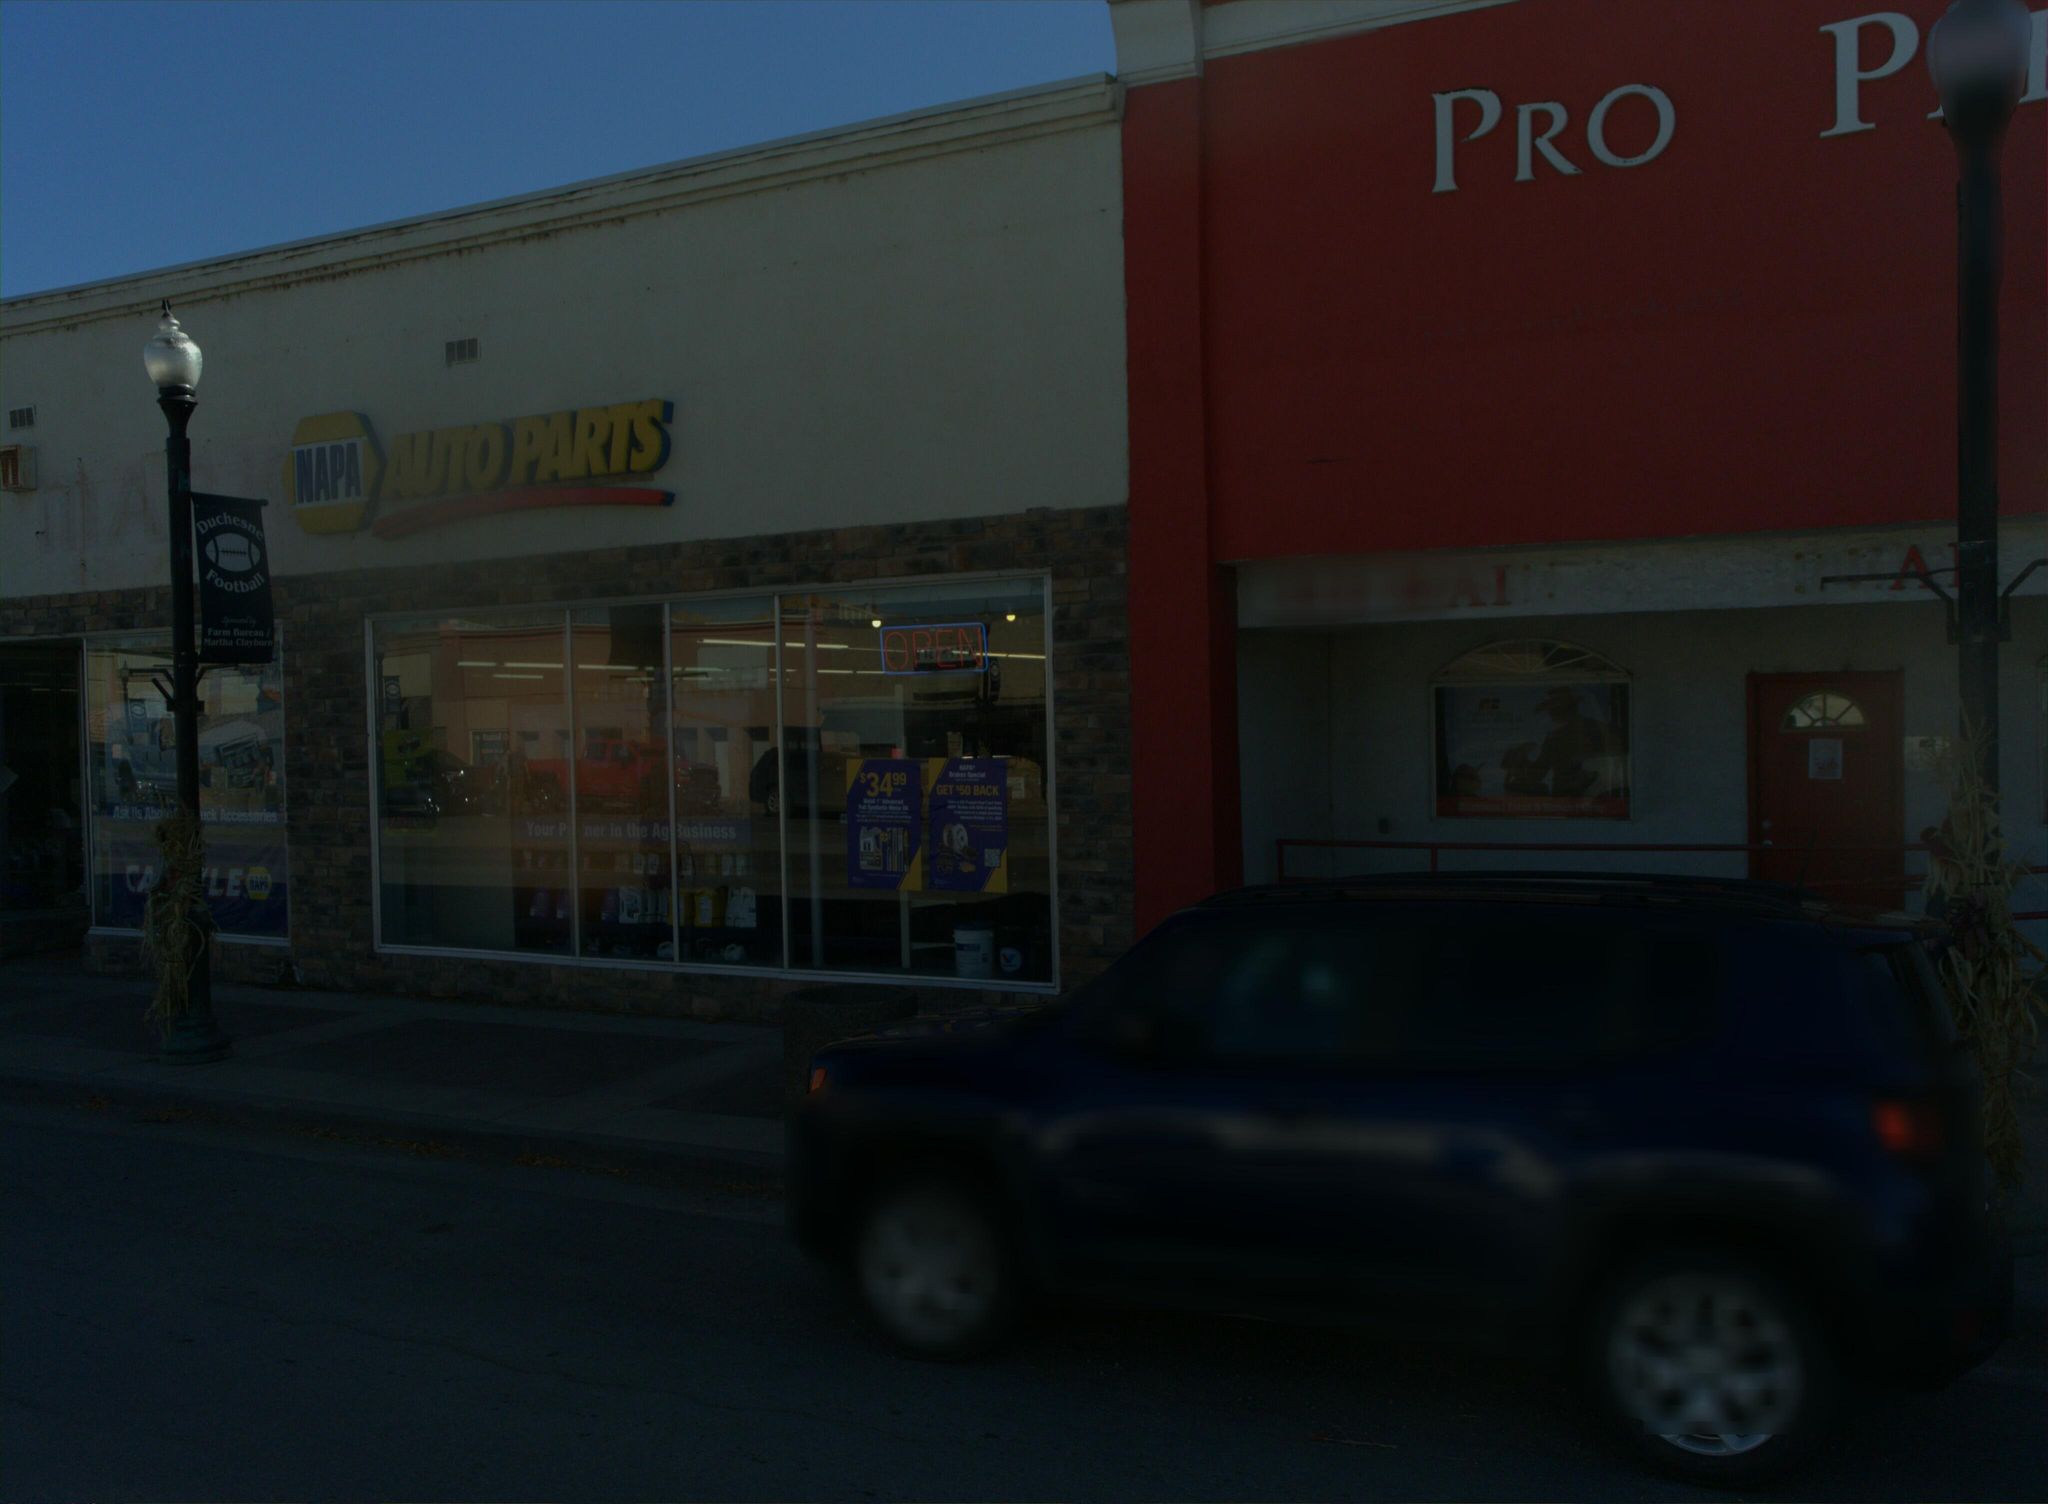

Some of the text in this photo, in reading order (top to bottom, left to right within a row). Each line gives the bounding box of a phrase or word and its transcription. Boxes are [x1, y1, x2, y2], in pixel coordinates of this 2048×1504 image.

[295, 400, 674, 504] NAPA AUTO PARTS
[196, 511, 264, 542] Duchesne
[206, 568, 266, 593] Football
[207, 627, 231, 637] Farm
[233, 627, 265, 637] Bureau
[203, 638, 233, 647] Martha
[885, 627, 983, 672] OPEN
[935, 784, 953, 796] GET
[973, 784, 1000, 797] BACK
[113, 805, 130, 819] Ask
[220, 808, 278, 823] Accessories
[526, 821, 556, 838] Your
[610, 822, 623, 838] in
[626, 823, 649, 838] the
